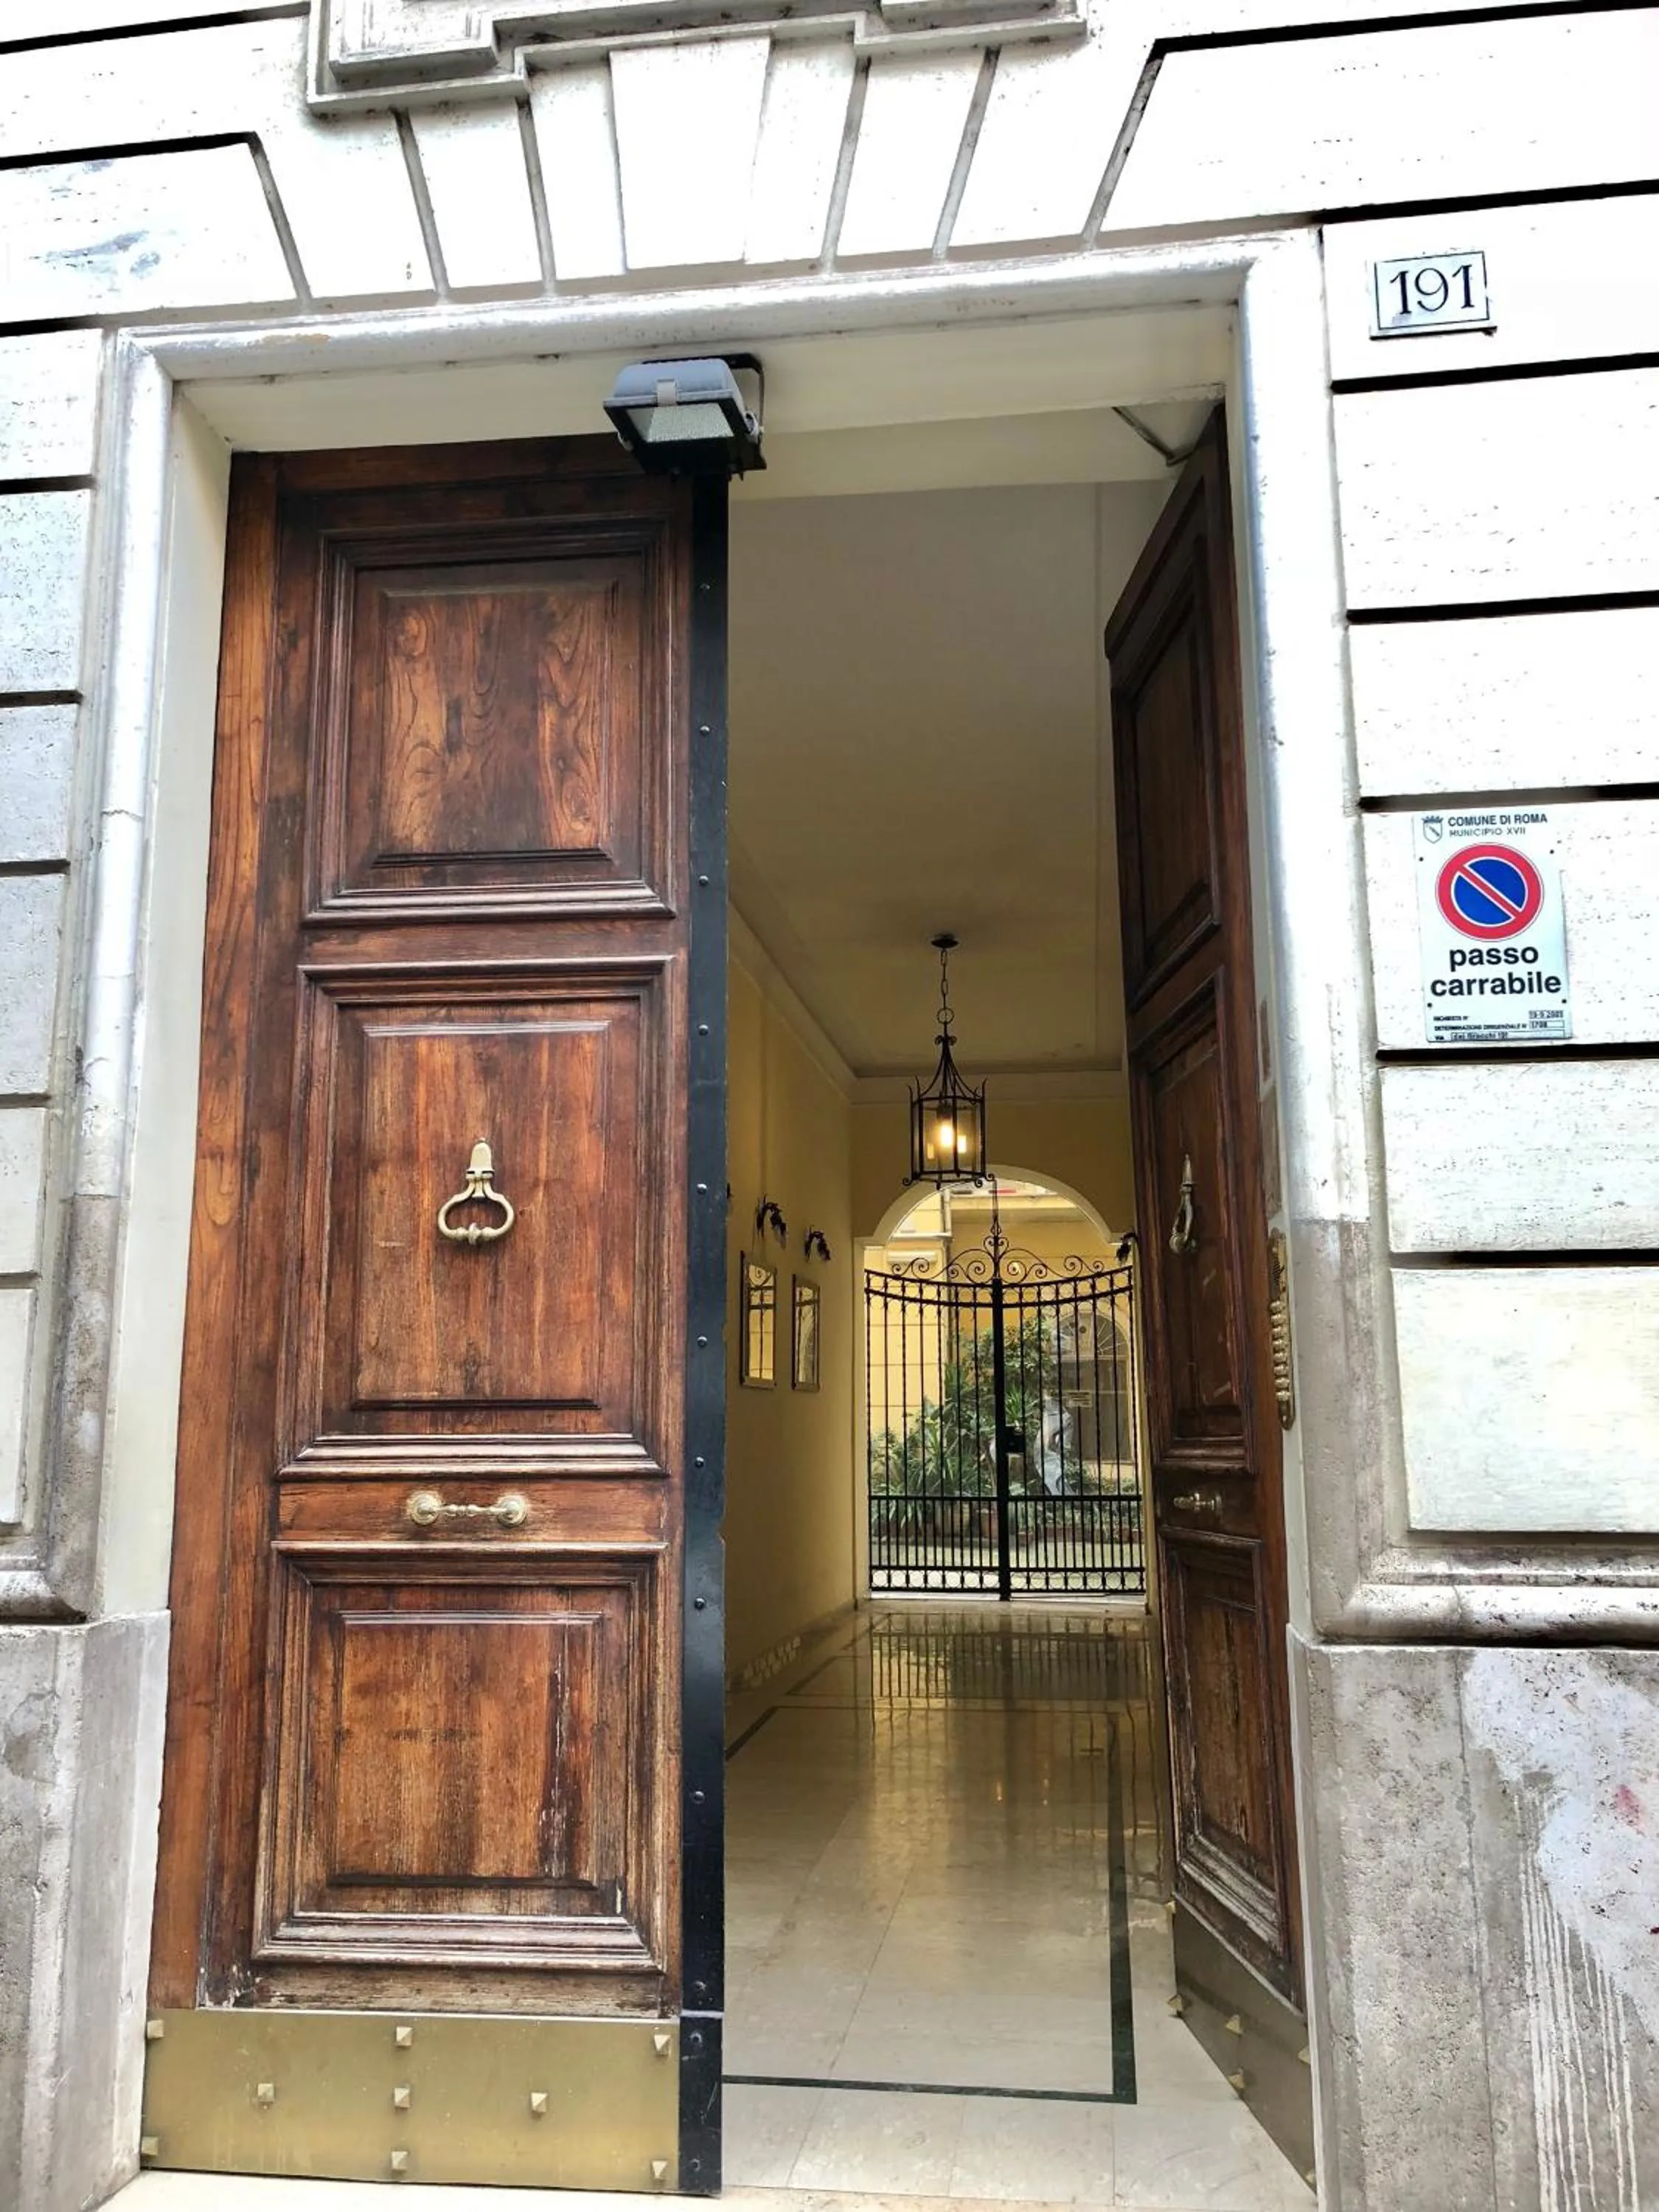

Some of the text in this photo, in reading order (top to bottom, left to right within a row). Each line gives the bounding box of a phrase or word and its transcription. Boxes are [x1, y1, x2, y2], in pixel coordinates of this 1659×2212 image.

[1390, 264, 1475, 315] 191
[1448, 813, 1548, 827] COMUNE DI ROMA
[1449, 827, 1526, 837] MUNICIPIO XVII
[1449, 946, 1539, 972] passo
[1430, 971, 1562, 997] carrabile
